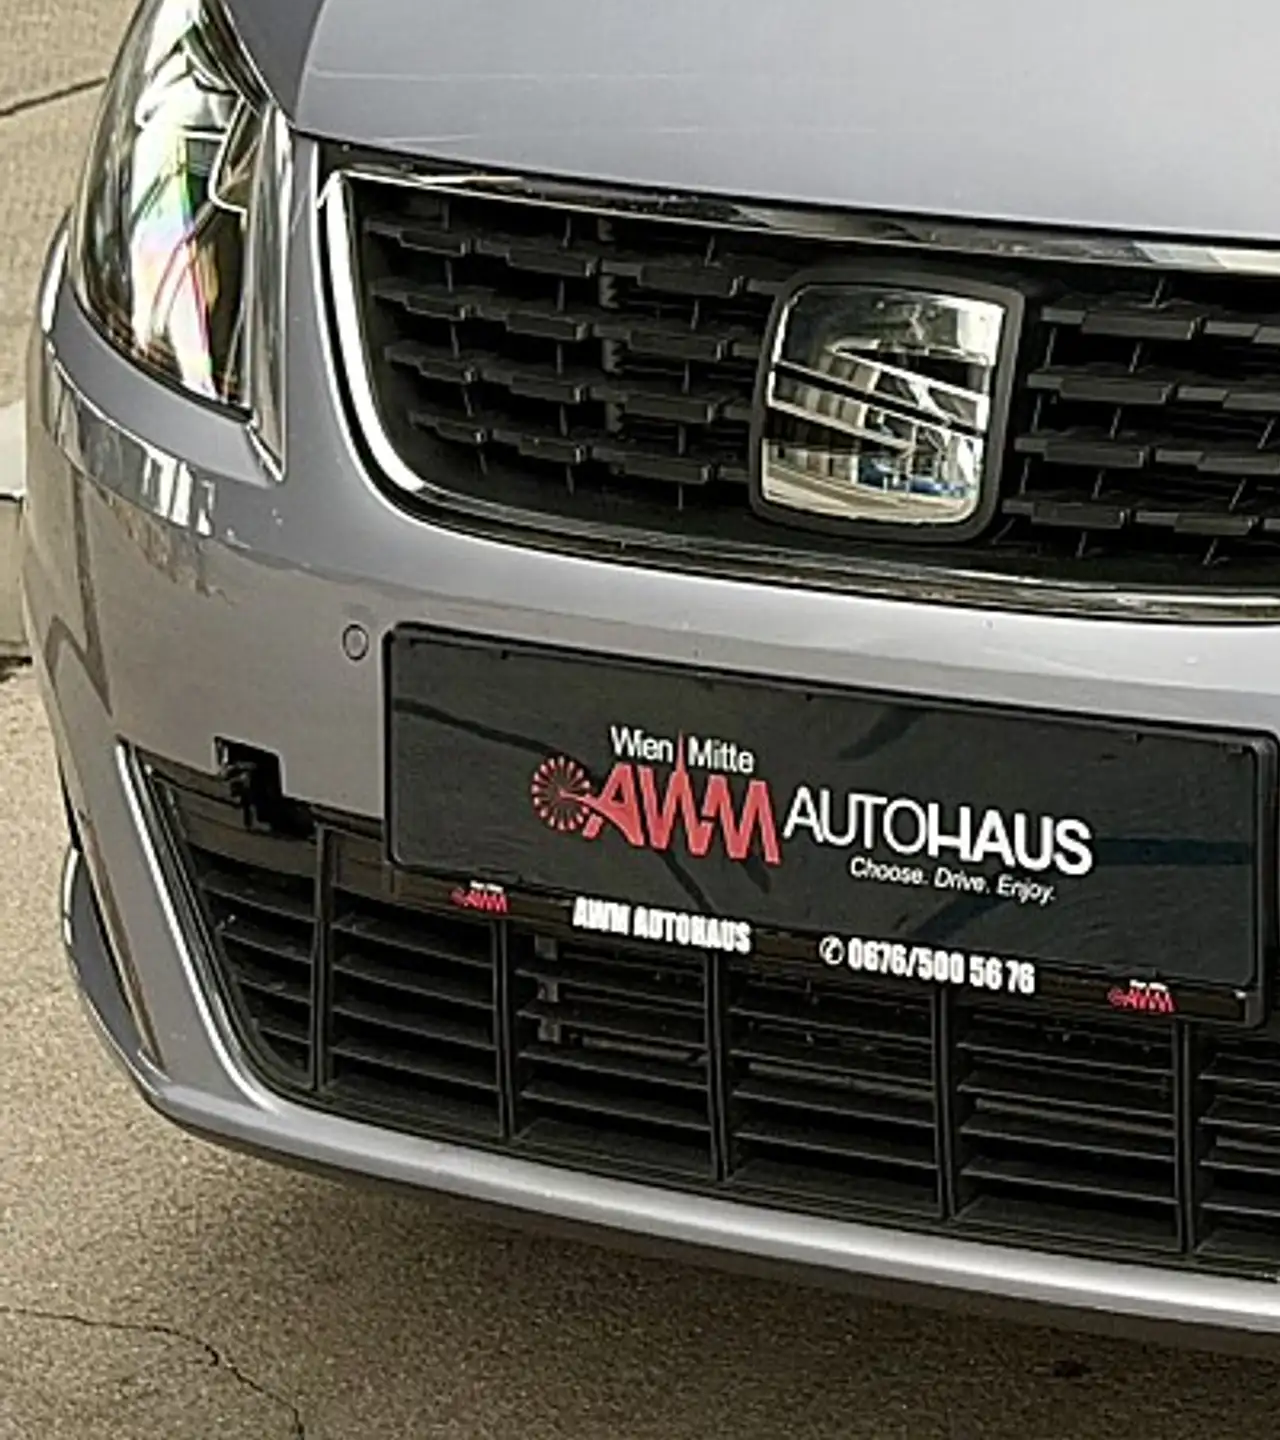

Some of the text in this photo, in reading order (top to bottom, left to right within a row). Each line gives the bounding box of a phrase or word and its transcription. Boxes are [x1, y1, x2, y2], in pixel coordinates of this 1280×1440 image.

[610, 725, 755, 773] Wien Mitte
[582, 730, 780, 864] AWM
[783, 786, 1093, 876] AUTOHAUS
[850, 856, 1057, 906] Choose. Drive. Enjoy.
[572, 896, 751, 955] AWM AUTOHAUS
[847, 937, 1035, 994] 0676/500 56 76
